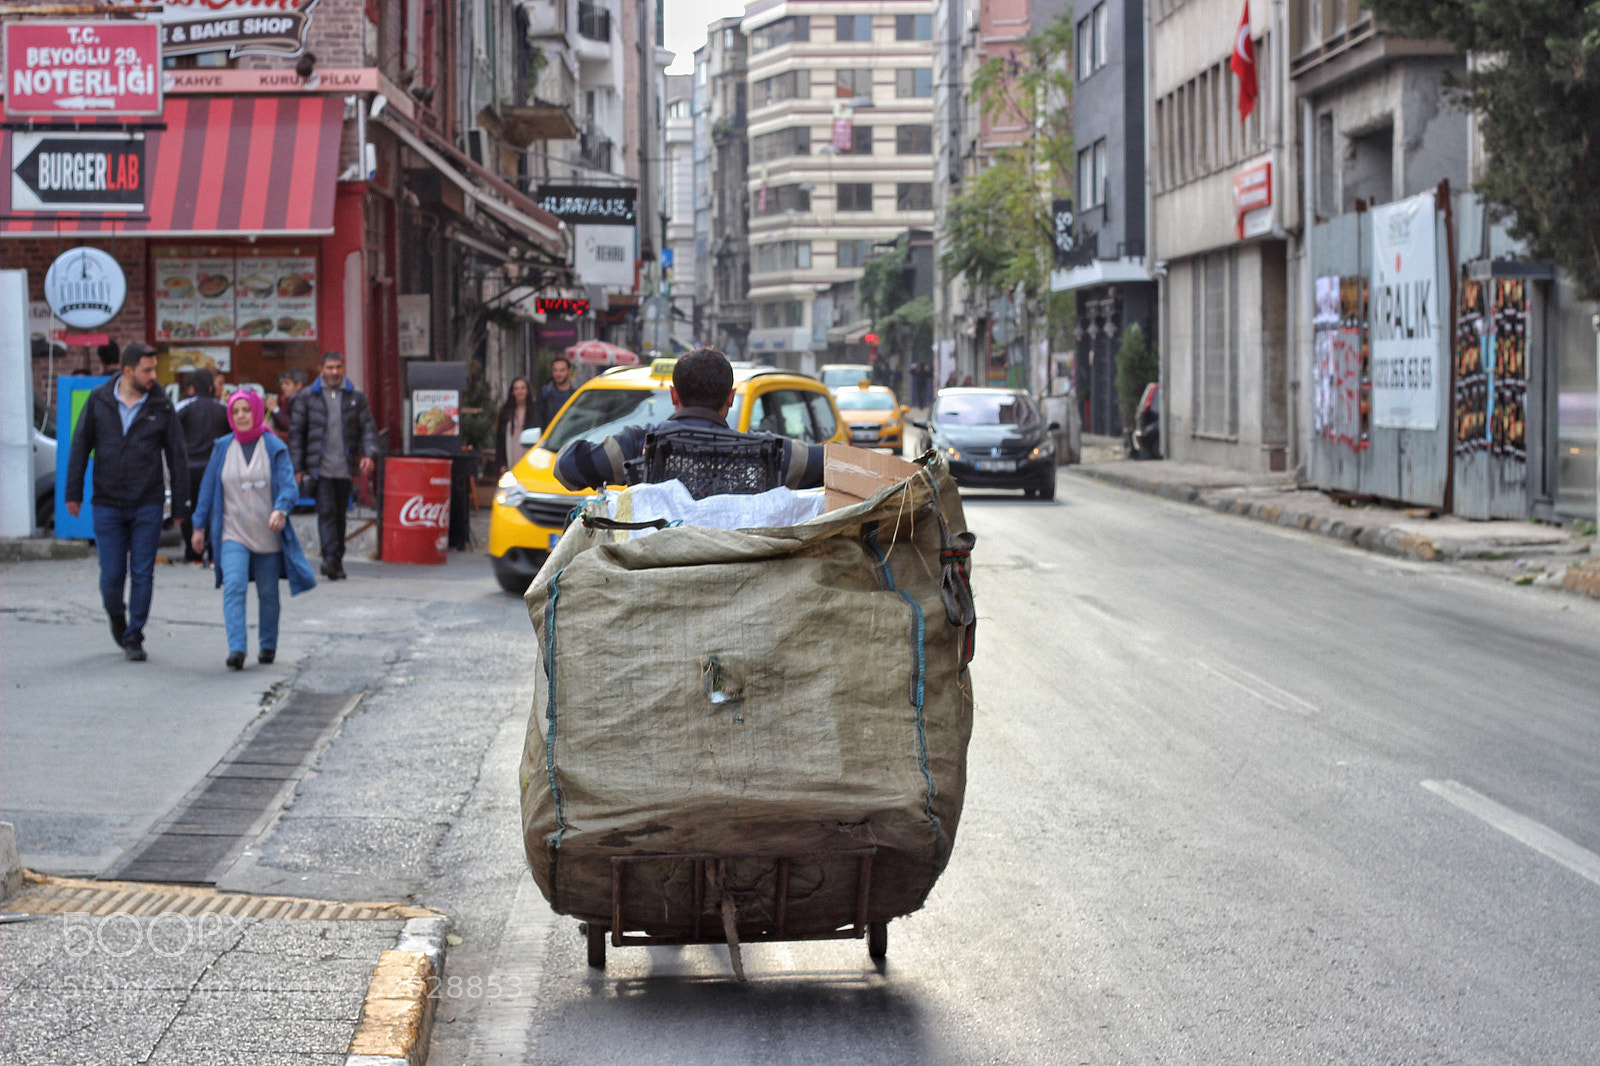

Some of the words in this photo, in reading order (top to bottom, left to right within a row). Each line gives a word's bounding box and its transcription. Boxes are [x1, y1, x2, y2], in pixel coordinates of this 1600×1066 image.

[66, 26, 101, 45] T.C.
[171, 26, 187, 42] &
[190, 20, 240, 39] BAKE
[242, 18, 294, 35] SHOP
[26, 45, 111, 67] BEYOĞLU
[114, 46, 143, 67] 29.
[13, 64, 155, 96] NOTERLİĞİ
[174, 75, 224, 86] KAHVE
[259, 74, 300, 86] KURU
[319, 72, 362, 86] PİLAV
